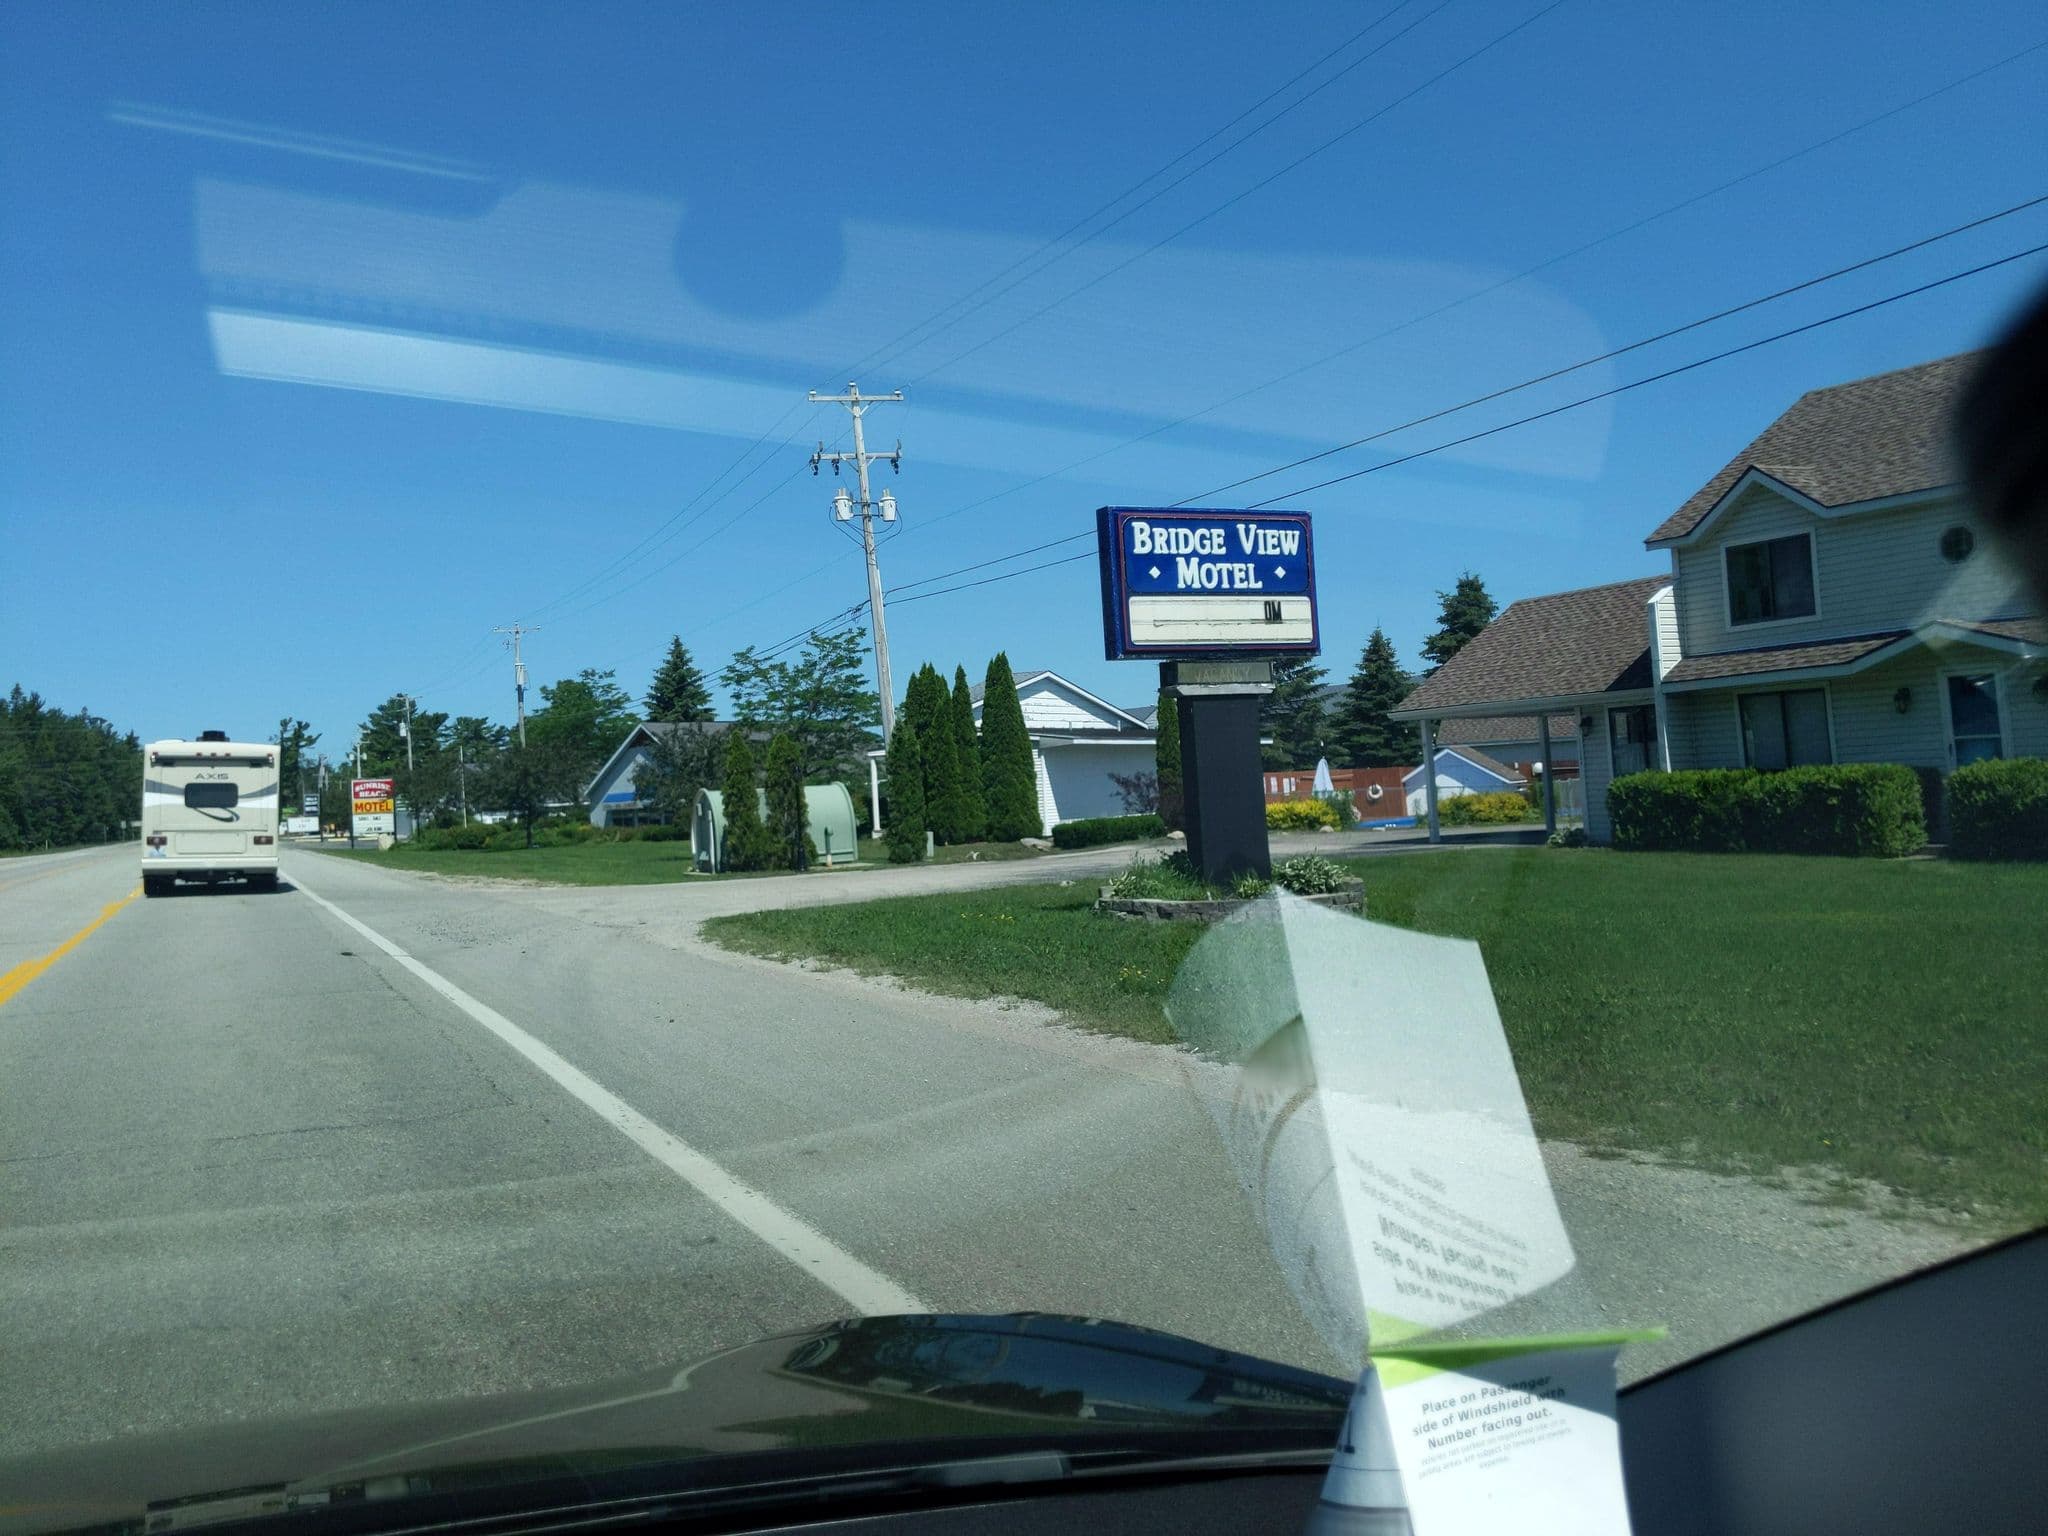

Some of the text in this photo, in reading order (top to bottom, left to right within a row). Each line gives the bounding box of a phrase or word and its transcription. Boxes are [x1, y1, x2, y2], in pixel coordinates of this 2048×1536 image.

[1131, 521, 1300, 556] BRIDGE VIEW
[1176, 557, 1263, 589] MOTEL
[355, 801, 392, 812] MOTEL
[1422, 1376, 1551, 1415] Place on Passenger
[1412, 1417, 1438, 1437] side
[1442, 1413, 1455, 1427] of
[1457, 1395, 1532, 1422] Windshield
[1428, 1427, 1478, 1449] Number
[1482, 1414, 1522, 1433] facing
[1527, 1407, 1553, 1421] out.
